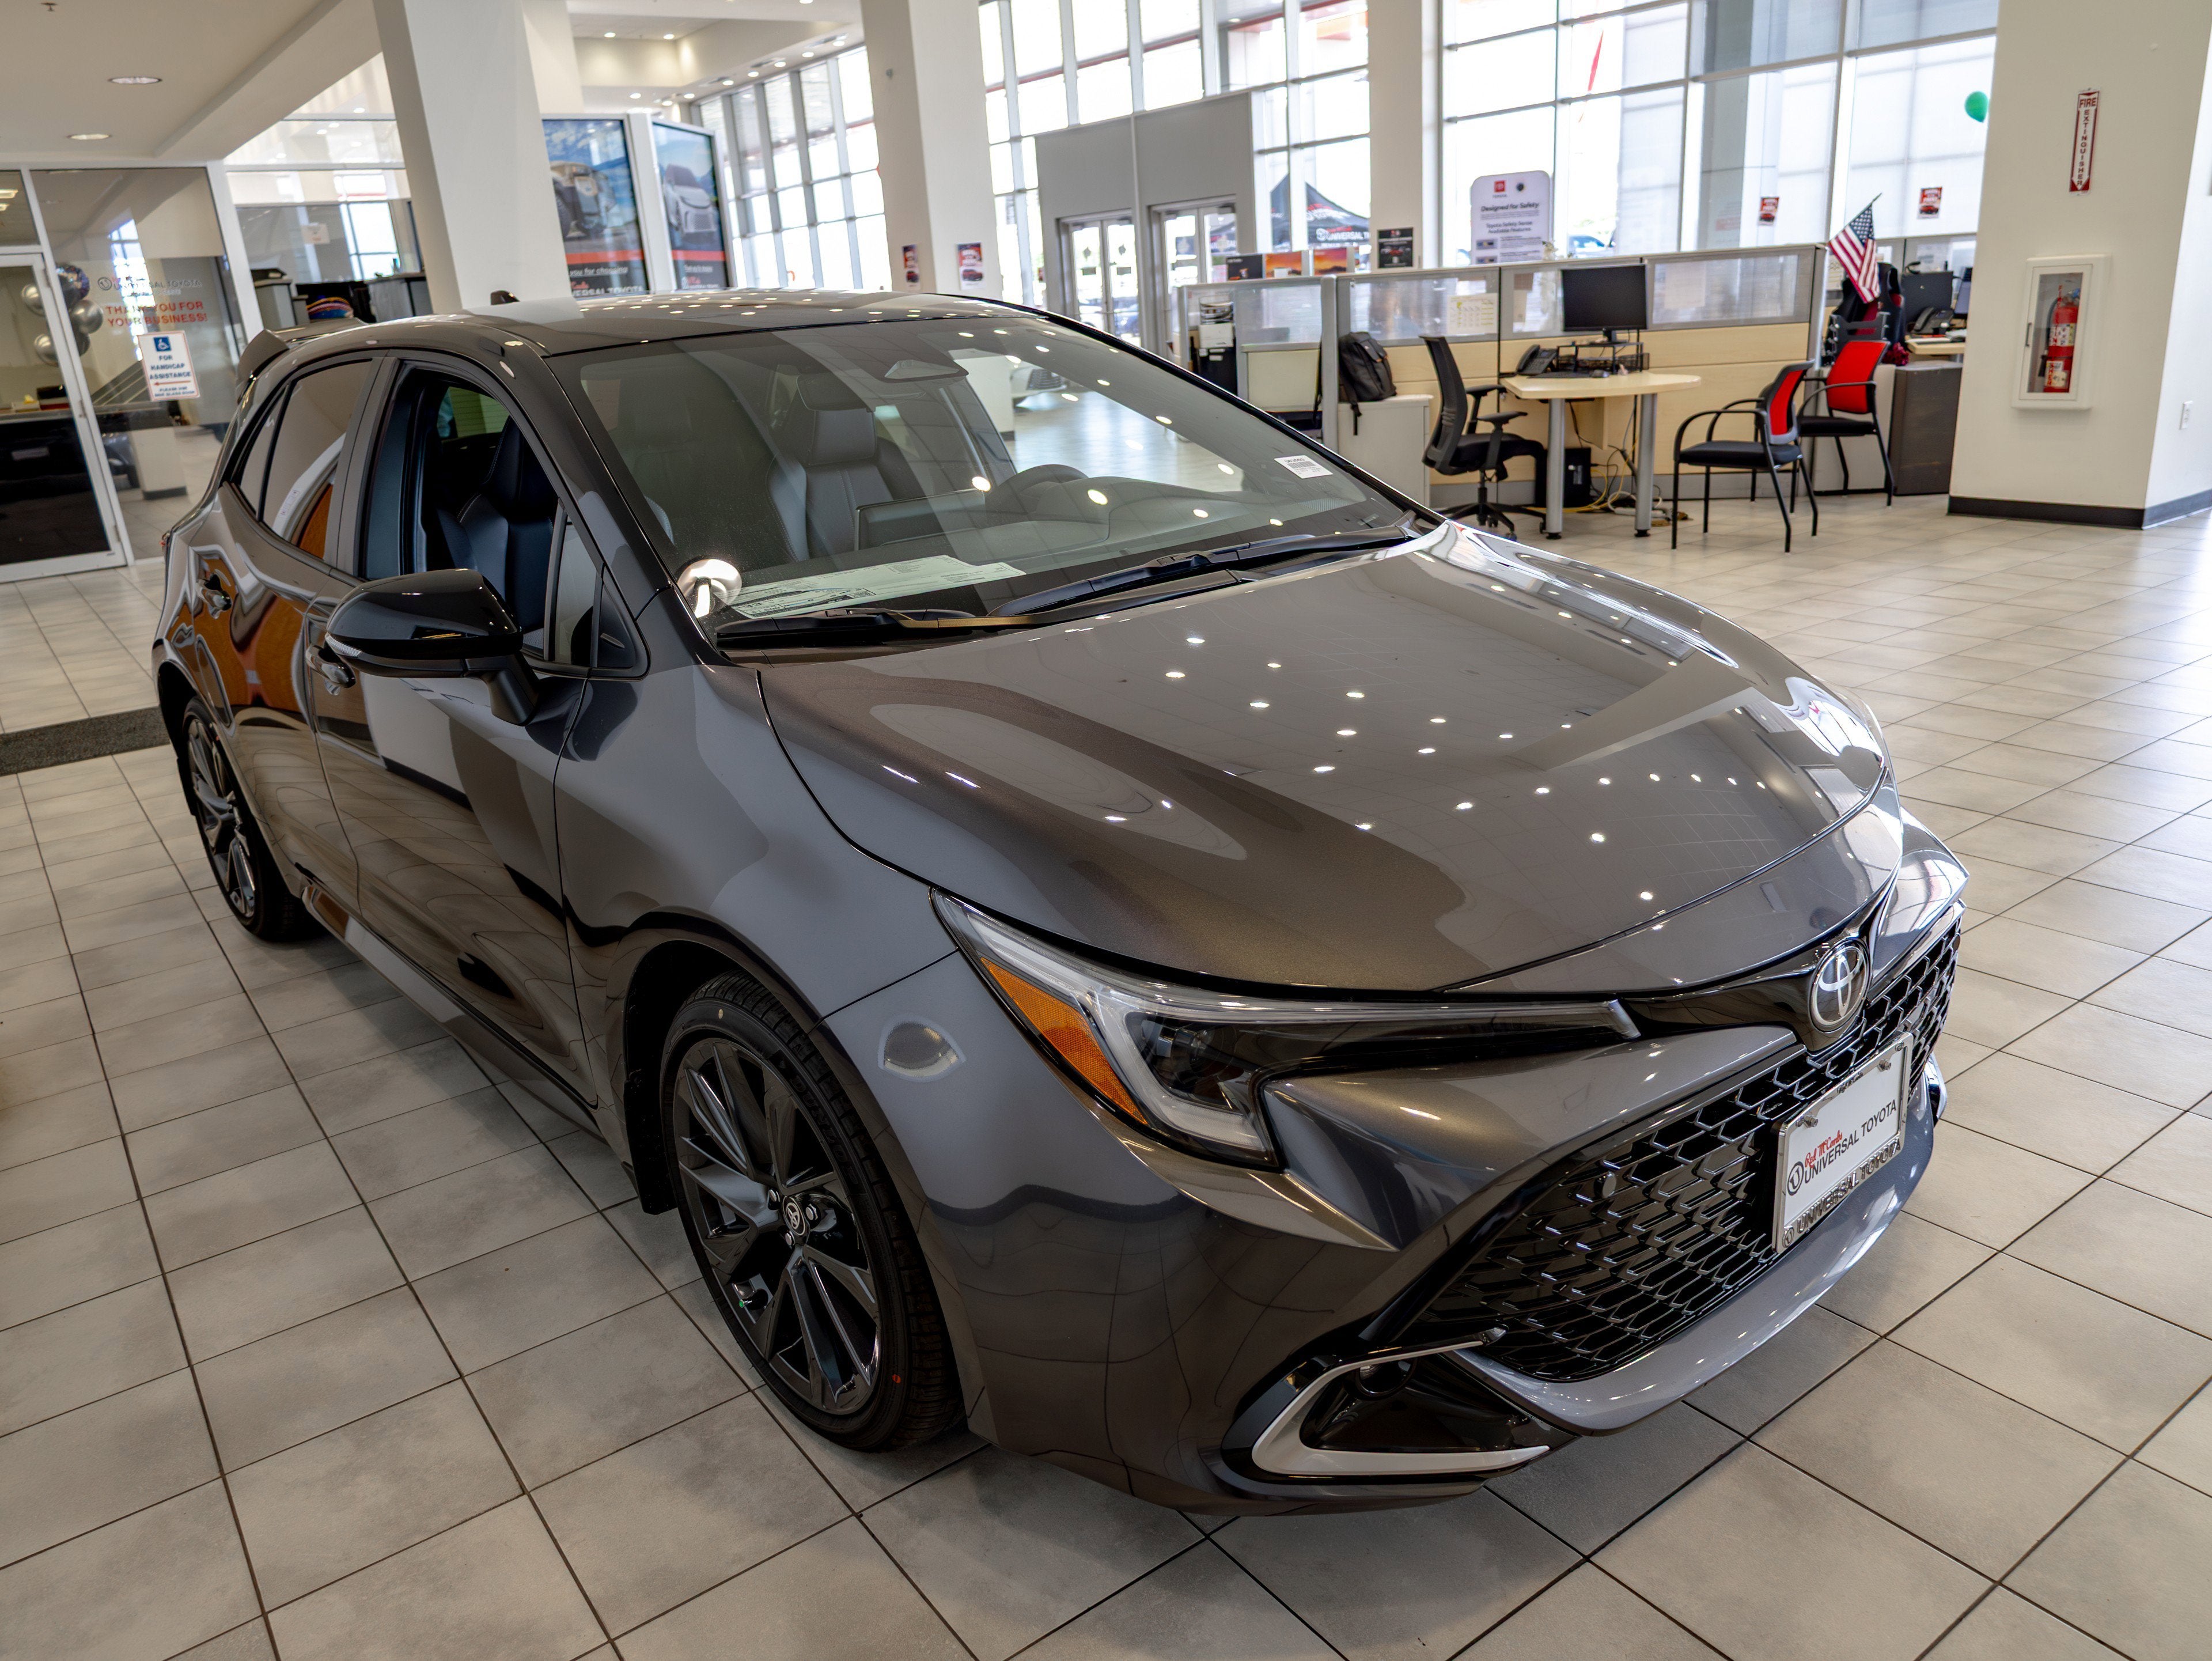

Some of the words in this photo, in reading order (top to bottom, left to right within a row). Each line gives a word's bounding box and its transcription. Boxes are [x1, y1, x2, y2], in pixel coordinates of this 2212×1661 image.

[2079, 97, 2097, 108] FIRE
[2077, 109, 2090, 186] EXTINGUISHER
[1480, 204, 1509, 212] Designed
[179, 301, 203, 311] FOR
[145, 313, 208, 324] BUSINESS!
[150, 372, 191, 380] ASSISTANCE
[1805, 1130, 1859, 1184] UNIVERSAL
[1861, 1099, 1896, 1137] TOYOTA
[1805, 1148, 1816, 1169] Red
[1797, 1171, 1859, 1234] UNIVERSAL
[1859, 1137, 1901, 1180] TOYOTA
